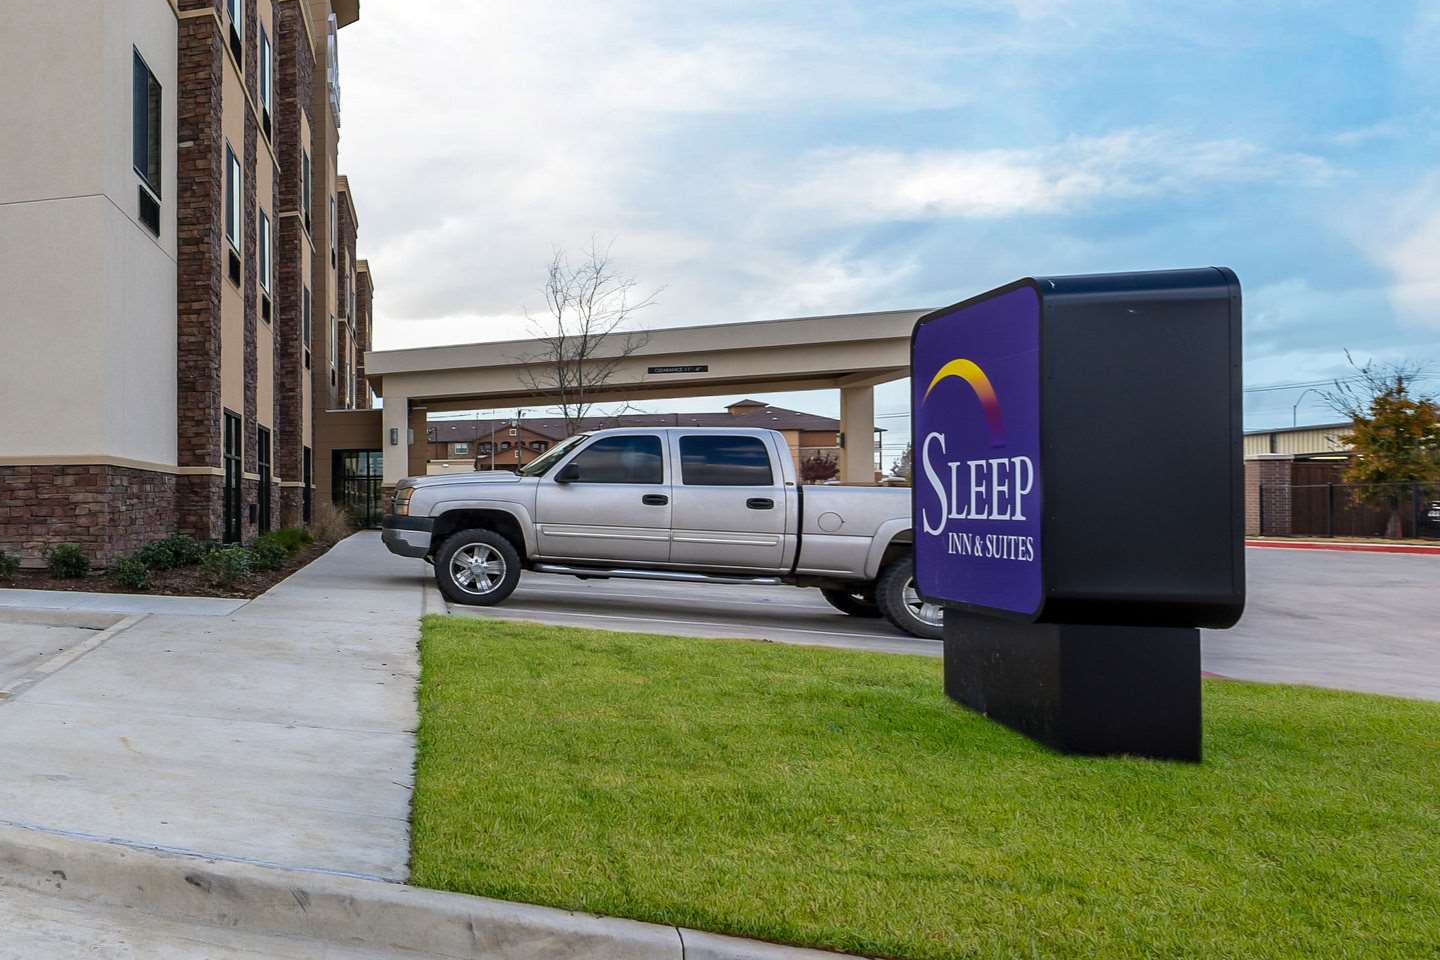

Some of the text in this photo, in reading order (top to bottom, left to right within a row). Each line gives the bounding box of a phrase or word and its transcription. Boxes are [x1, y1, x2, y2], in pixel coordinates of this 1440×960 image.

[922, 431, 1034, 536] SLEEP
[948, 532, 1034, 561] INN & SUITES
